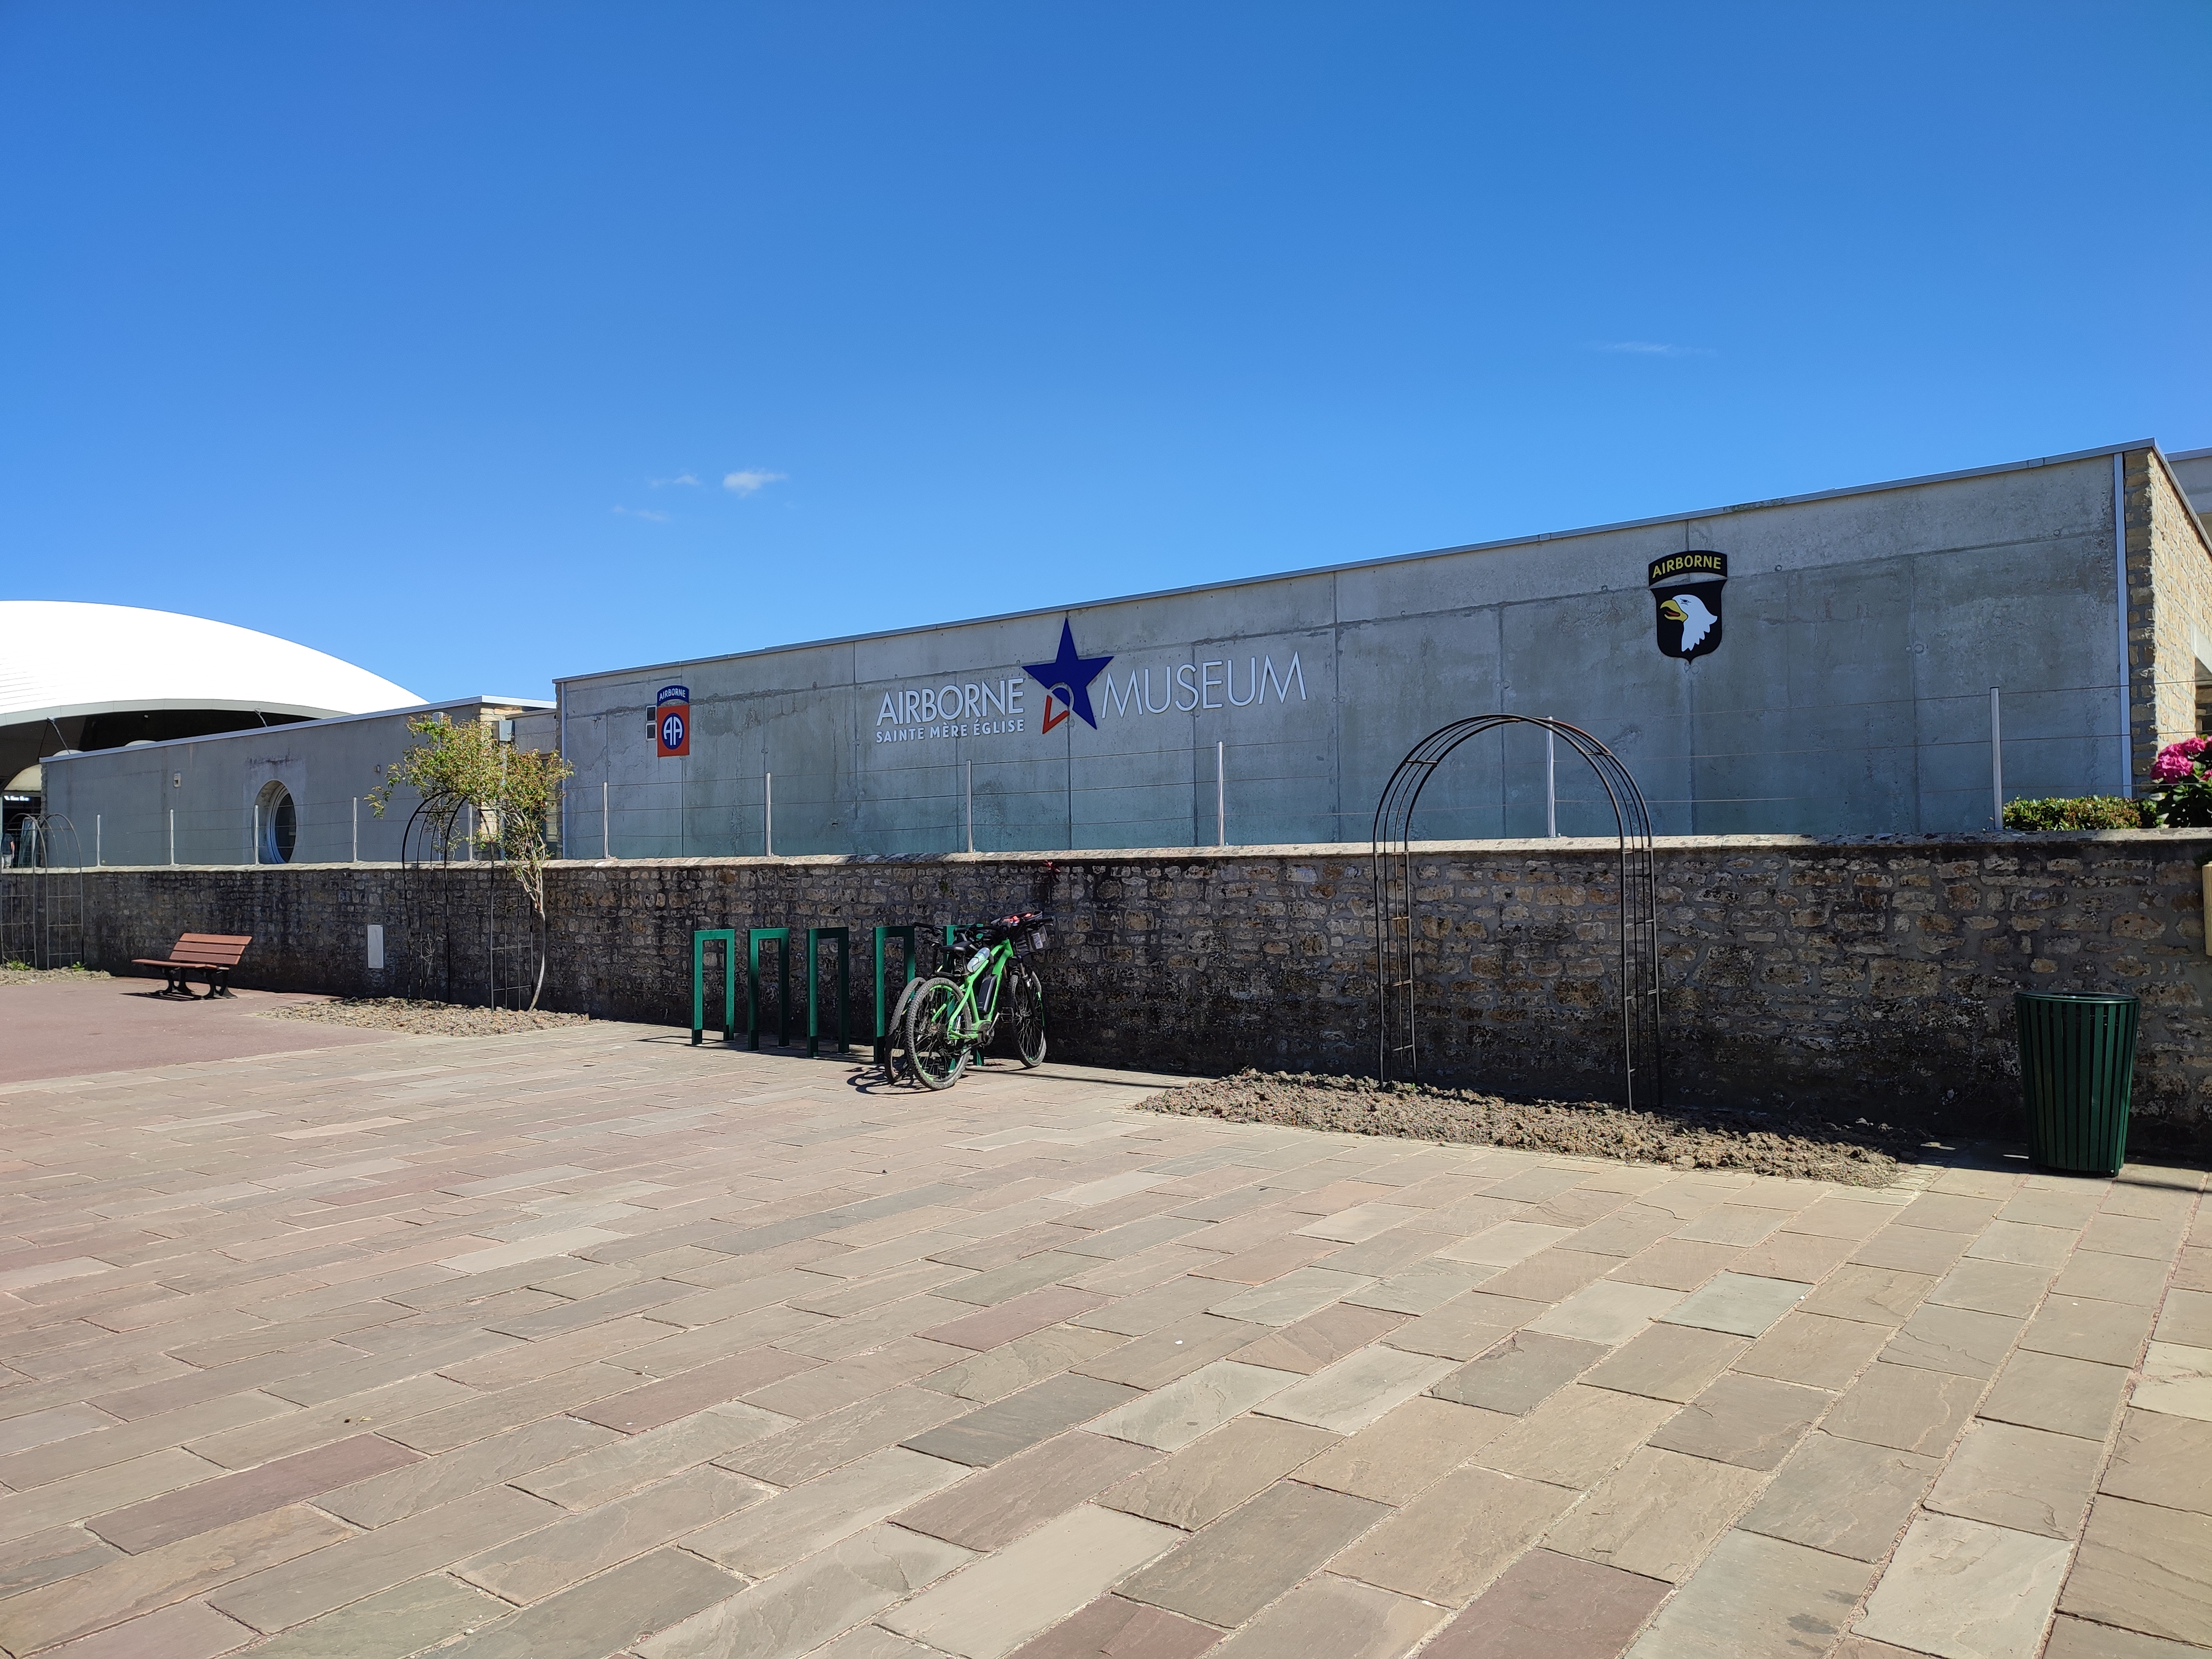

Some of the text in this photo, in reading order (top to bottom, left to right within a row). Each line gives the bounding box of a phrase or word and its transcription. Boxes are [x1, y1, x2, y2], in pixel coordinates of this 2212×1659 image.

[1652, 555, 1721, 579] AIRBORNE
[659, 687, 686, 701] AIRBORNE
[1101, 651, 1307, 719] MUSEUM
[876, 678, 1024, 726] AIRBORNE
[664, 716, 683, 746] AA
[876, 718, 1024, 743] SAINTE MÈRE ÉGLISE
